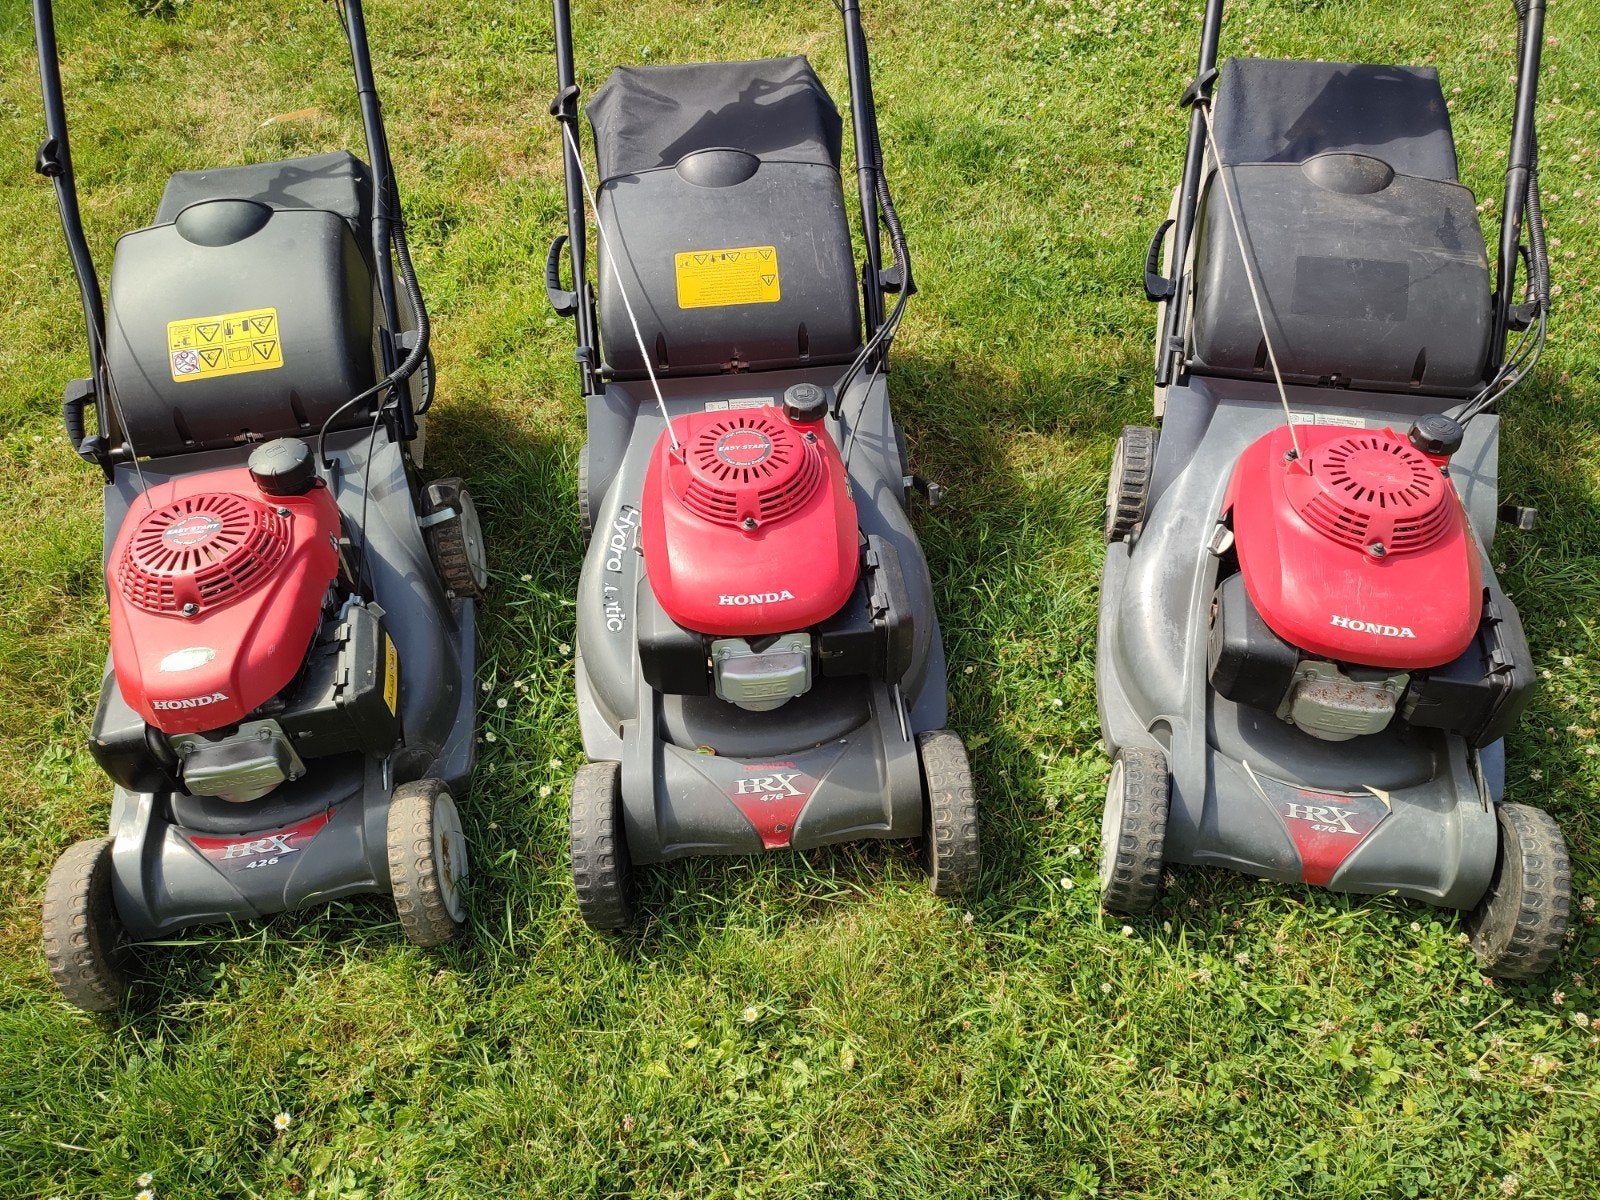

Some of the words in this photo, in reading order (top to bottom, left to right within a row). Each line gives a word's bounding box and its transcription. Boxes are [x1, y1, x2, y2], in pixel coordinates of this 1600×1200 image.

[718, 590, 796, 606] HONDA
[1330, 615, 1417, 638] HONDA
[152, 691, 230, 710] HONDA
[734, 773, 806, 797] HRX
[760, 793, 784, 802] 476
[1285, 802, 1362, 835] HRX
[1310, 823, 1338, 834] 476
[220, 831, 301, 860] HRX
[246, 856, 279, 869] 426
